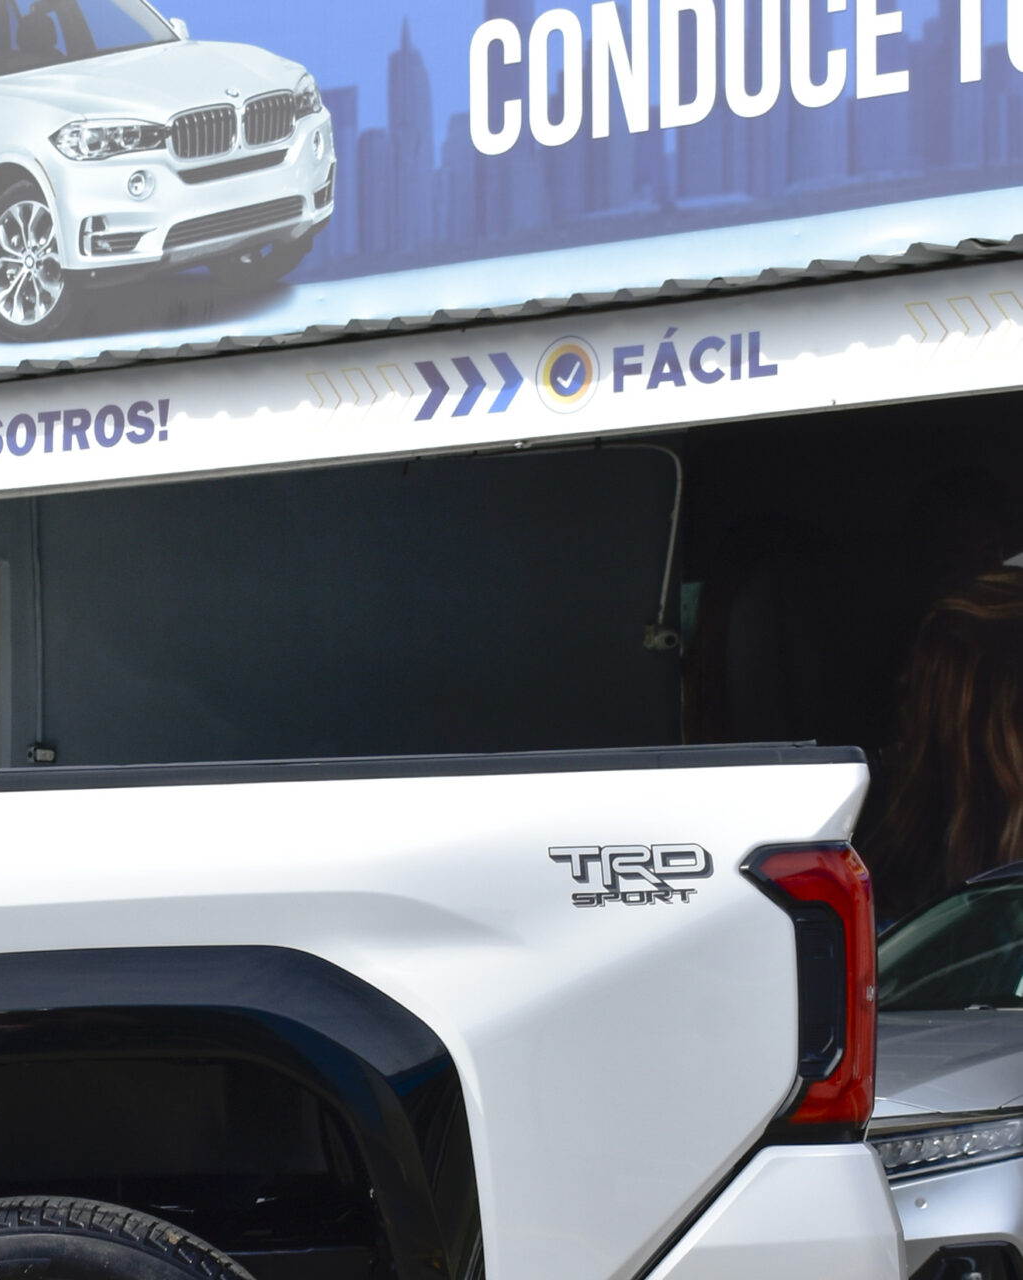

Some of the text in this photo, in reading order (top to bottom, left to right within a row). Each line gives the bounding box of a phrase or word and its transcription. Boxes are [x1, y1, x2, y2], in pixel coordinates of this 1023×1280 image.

[469, 0, 909, 155] CONDUCE
[612, 326, 778, 393] FÁCIL
[548, 843, 714, 892] TRD
[571, 888, 697, 908] SPORT
